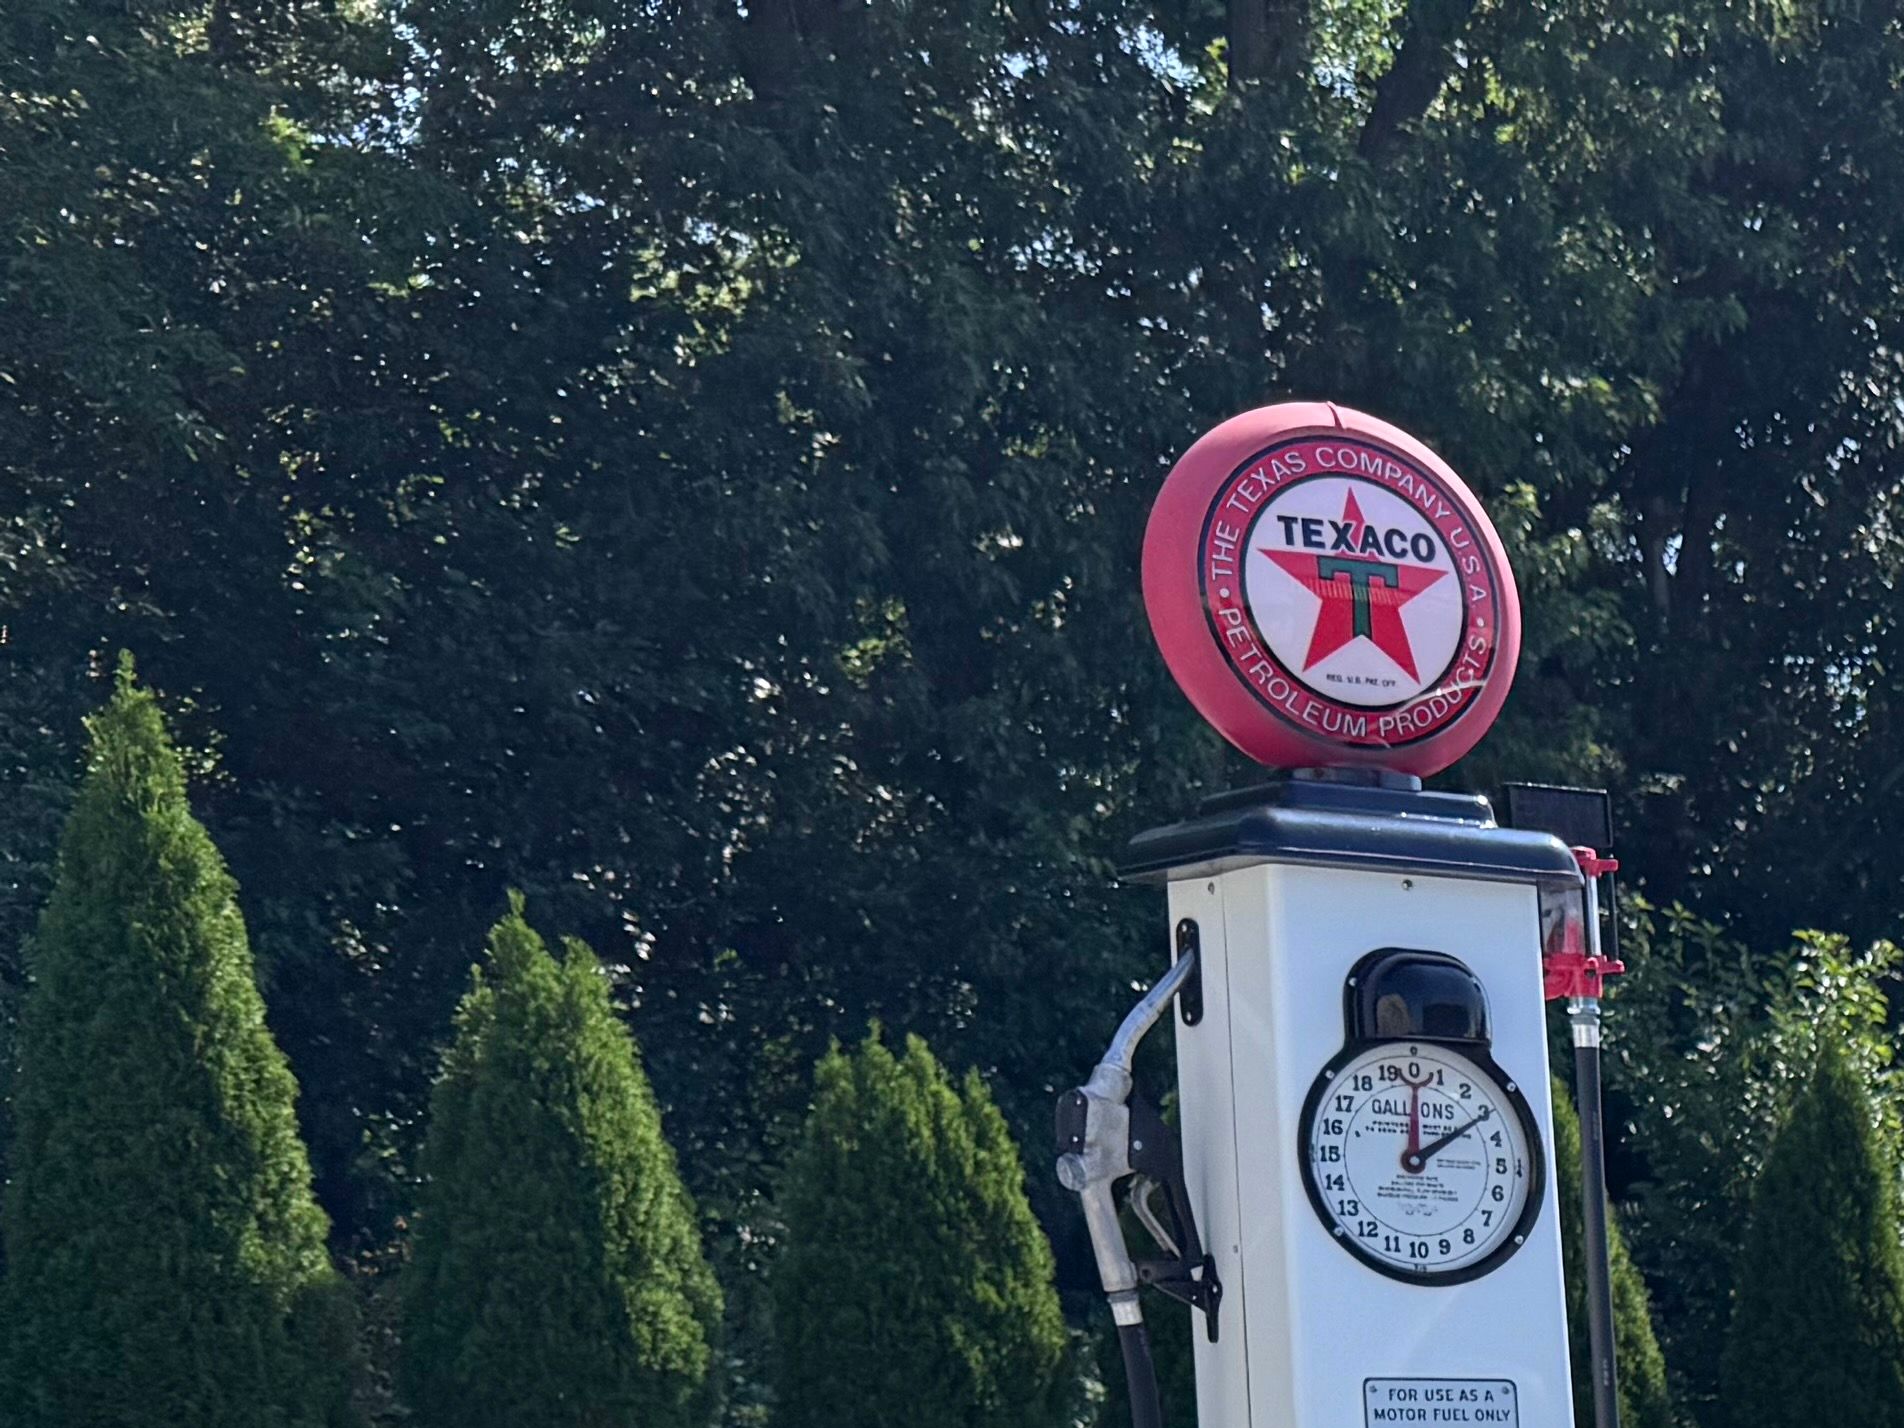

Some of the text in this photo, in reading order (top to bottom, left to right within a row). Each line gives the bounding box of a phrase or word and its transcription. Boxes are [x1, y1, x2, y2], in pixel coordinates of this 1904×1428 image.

[1211, 521, 1240, 580] THE
[1226, 452, 1306, 512] TEXAS
[1315, 447, 1450, 518] COMPANY
[1277, 515, 1436, 562] TEXACO
[1218, 607, 1486, 737] PETROLEUM PRODUCTS
[1378, 1065, 1399, 1082] 19
[1408, 1062, 1421, 1079] 0
[1436, 1069, 1445, 1085] 1
[1353, 1075, 1373, 1092] 18
[1459, 1083, 1472, 1100] 2
[1335, 1095, 1354, 1112] 17
[1371, 1099, 1455, 1120] GALLONS
[1477, 1104, 1491, 1121] 3
[1322, 1119, 1344, 1136] 16
[1489, 1131, 1502, 1148] 4
[1319, 1146, 1341, 1163] 15
[1495, 1158, 1508, 1175] 5
[1324, 1174, 1345, 1191] 14
[1492, 1185, 1504, 1201] 6
[1338, 1200, 1359, 1217] 13
[1481, 1210, 1493, 1227] 7
[1358, 1221, 1379, 1238] 12
[1463, 1228, 1475, 1245] 8
[1384, 1236, 1401, 1253] 11
[1408, 1241, 1429, 1259] 10
[1438, 1239, 1451, 1255] 9
[1388, 1388, 1495, 1402] FOR USE AS A
[1374, 1408, 1511, 1422] MOTOR FUEL ONLY
